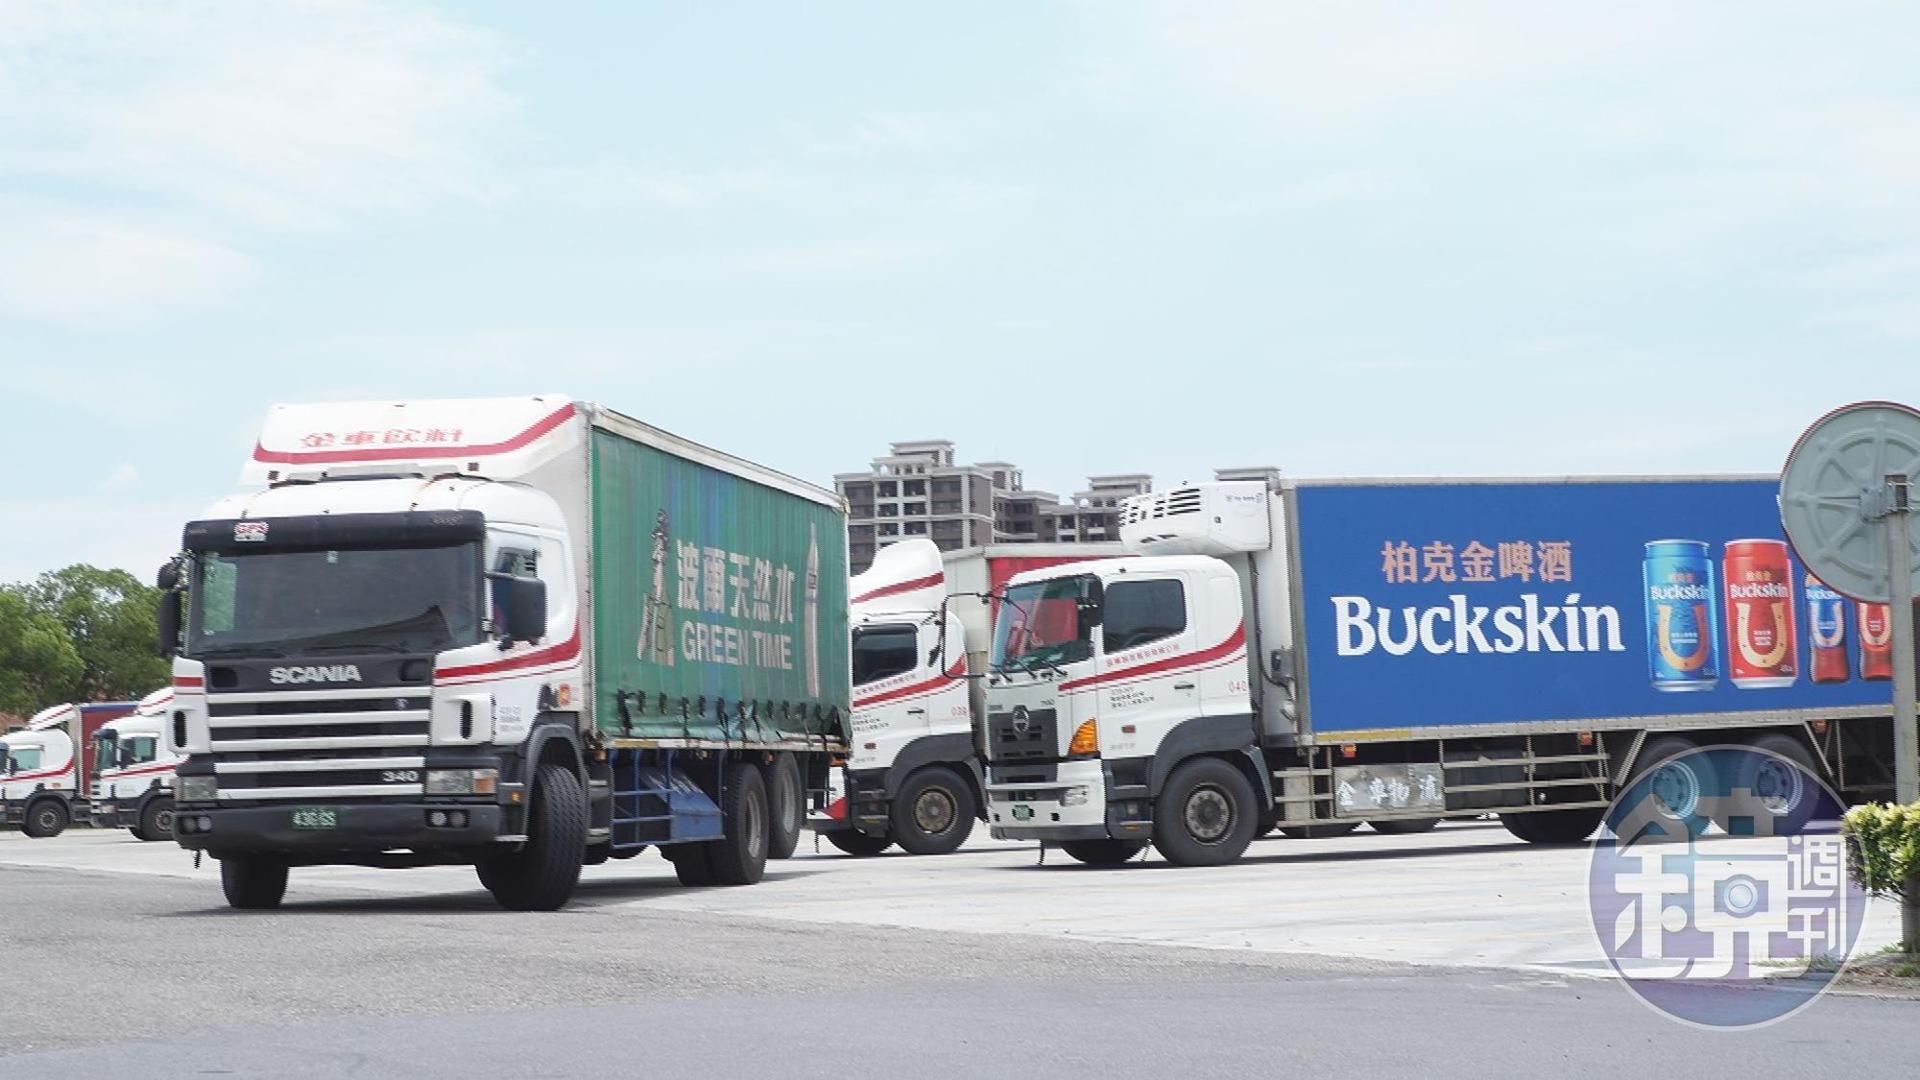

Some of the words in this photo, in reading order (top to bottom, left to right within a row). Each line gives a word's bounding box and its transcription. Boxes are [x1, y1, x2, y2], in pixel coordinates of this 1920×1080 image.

[1380, 540, 1573, 584] 柏克金啤酒
[1730, 582, 1790, 599] Buckskin
[681, 620, 750, 666] GREEN
[752, 630, 793, 670] TIME
[269, 664, 364, 685] SCANIA
[382, 770, 420, 782] 340
